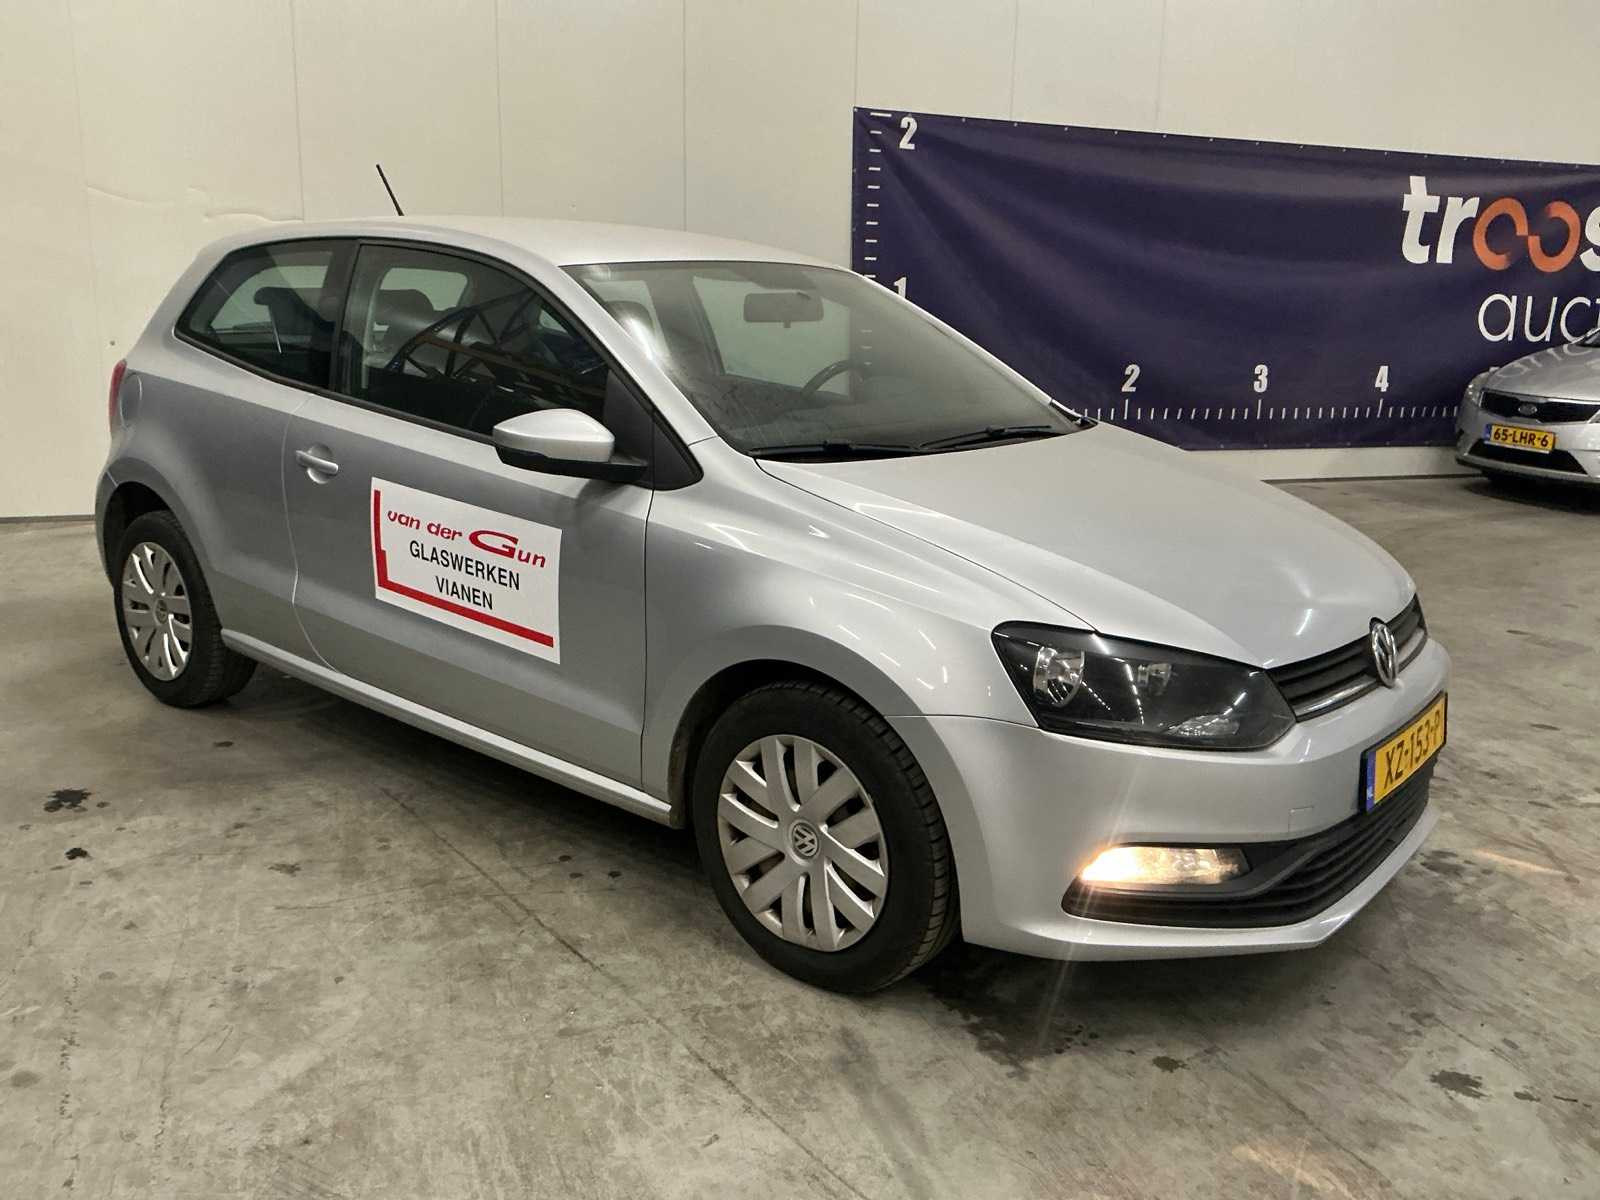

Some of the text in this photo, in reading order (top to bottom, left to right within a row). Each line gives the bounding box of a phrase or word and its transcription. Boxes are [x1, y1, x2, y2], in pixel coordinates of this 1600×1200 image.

[899, 116, 918, 150] 2
[1477, 293, 1600, 344] auc
[1121, 364, 1389, 393] 2 3 4
[1493, 427, 1549, 448] 65-LHR-6
[387, 510, 547, 568] van der Gun
[409, 540, 520, 590] GLASWERKEN
[435, 575, 493, 610] VIANEN
[1383, 709, 1440, 790] XZ-153-P
